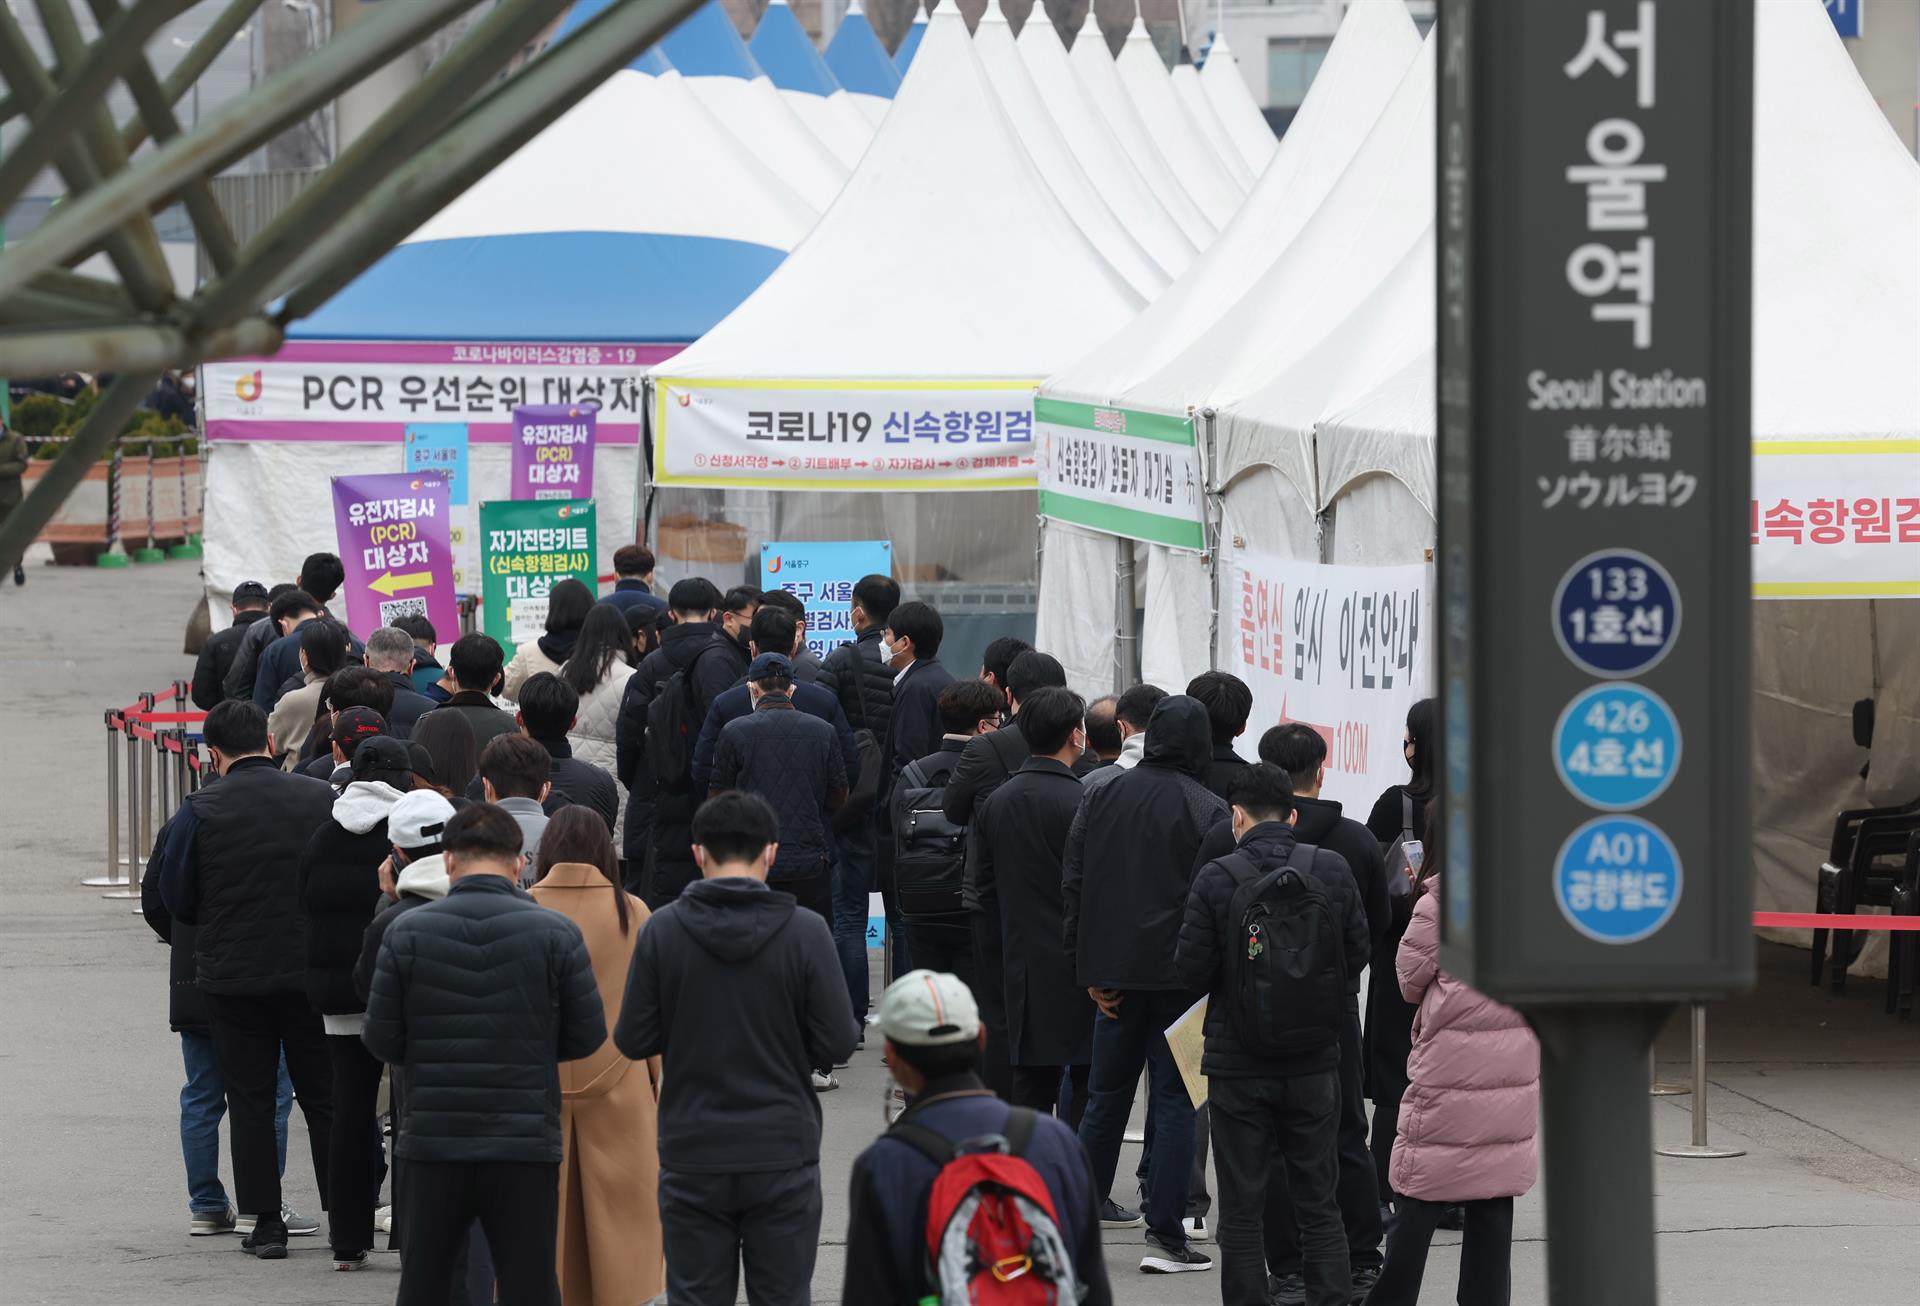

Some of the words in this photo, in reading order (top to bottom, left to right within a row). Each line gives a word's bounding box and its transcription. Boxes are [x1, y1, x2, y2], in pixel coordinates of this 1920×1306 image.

[1564, 0, 1667, 349] 서울역
[452, 346, 601, 364] 코로나바이러스감염증
[617, 348, 636, 363] 19
[302, 375, 384, 411] PCR
[398, 375, 526, 413] 우선순위
[543, 377, 641, 413] 대상자
[1527, 369, 1603, 411] Seoul
[1609, 368, 1707, 409] Station
[522, 424, 588, 446] 유전자검사
[746, 411, 873, 443] 코로나19
[883, 410, 1032, 444] 신속항원검
[1564, 424, 1672, 462] 首尔站
[536, 446, 573, 463] (PCR)
[710, 454, 769, 468] 신청서작성
[804, 457, 852, 470] 키트배부
[888, 457, 936, 471] 자가검사
[1057, 435, 1107, 491] 신속항원검사
[1110, 444, 1139, 498] 완료자
[1144, 449, 1173, 505] 대기실
[528, 463, 580, 484] 대상자
[1537, 472, 1699, 509] ソウルヨク
[349, 497, 436, 526] 유전자검사
[370, 521, 417, 546] (PCR)
[489, 527, 589, 553] 자가진단키트
[363, 541, 430, 571] 대상자
[489, 552, 590, 575] (신속항원검사)
[784, 560, 809, 569] 서울중구
[820, 581, 853, 602] 서울
[1586, 566, 1650, 601] 133
[1240, 569, 1285, 676] 흡연실
[1294, 586, 1329, 686] 임시
[1339, 588, 1419, 690] 이전안내
[1569, 605, 1666, 646] 1호선
[1585, 700, 1650, 734] 426
[1338, 720, 1369, 776] 100M
[1567, 737, 1666, 778] 4호선
[1586, 831, 1649, 866] A01
[1567, 869, 1668, 912] 공항철도
